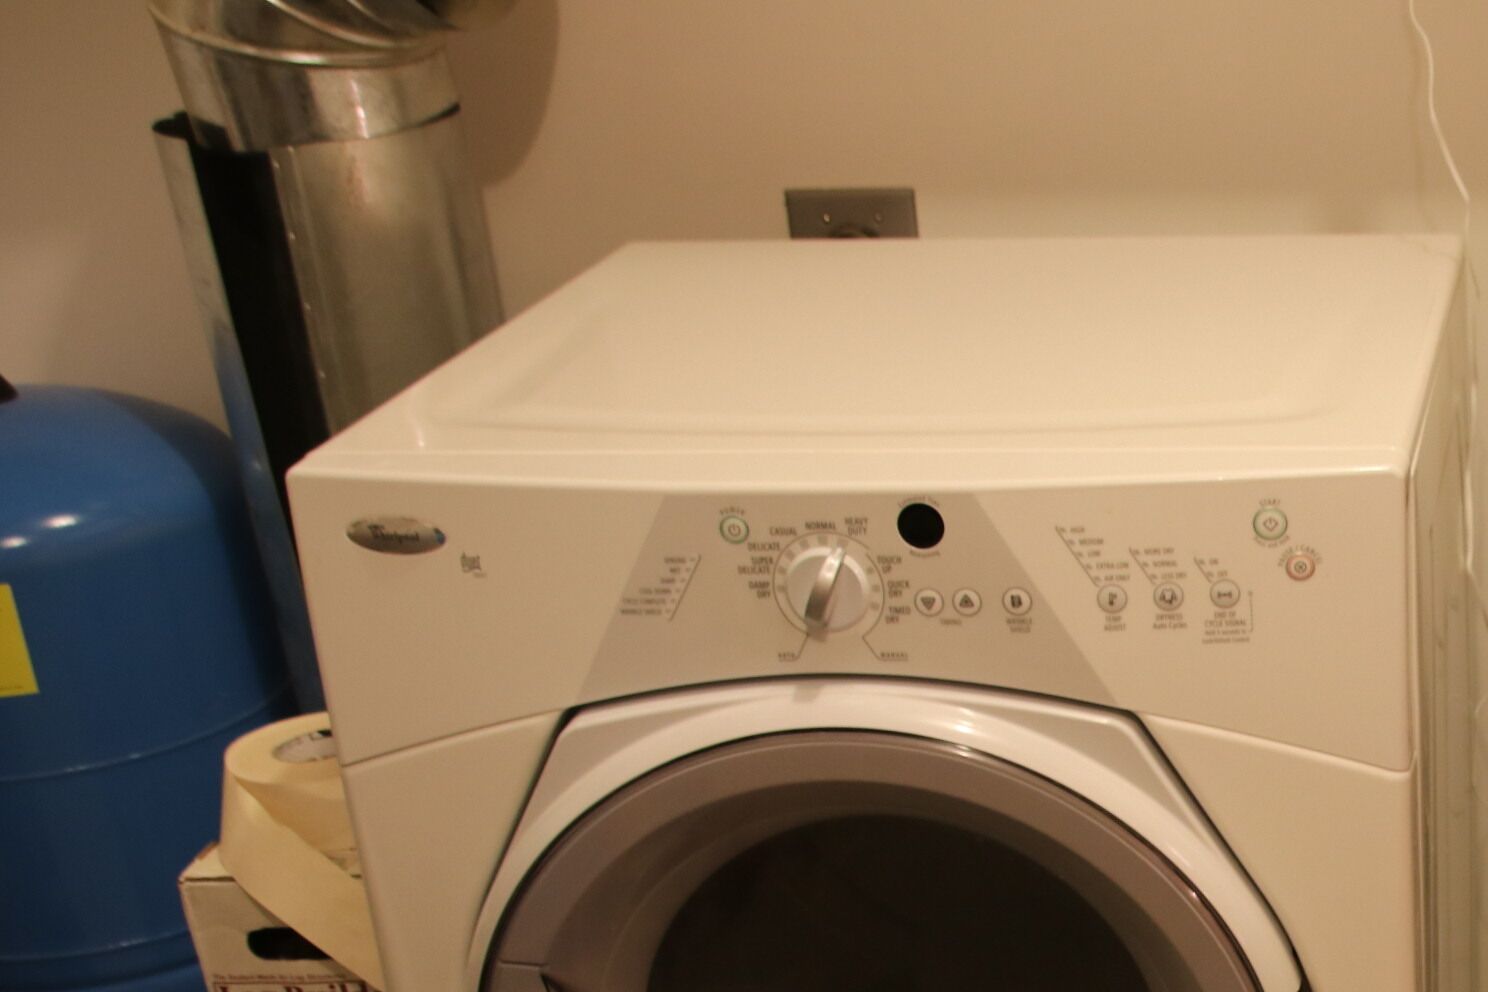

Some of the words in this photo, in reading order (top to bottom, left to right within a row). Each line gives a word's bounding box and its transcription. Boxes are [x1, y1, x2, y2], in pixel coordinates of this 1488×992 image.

[805, 520, 836, 530] NORMAL
[845, 517, 868, 525] HEAVY
[769, 527, 797, 536] CASUAL
[848, 527, 867, 536] DUTY
[747, 542, 780, 551] DELICATE
[751, 556, 773, 565] SUPER
[737, 566, 770, 575] DELICATE
[748, 581, 770, 590] DAMP
[756, 590, 771, 599] DRY
